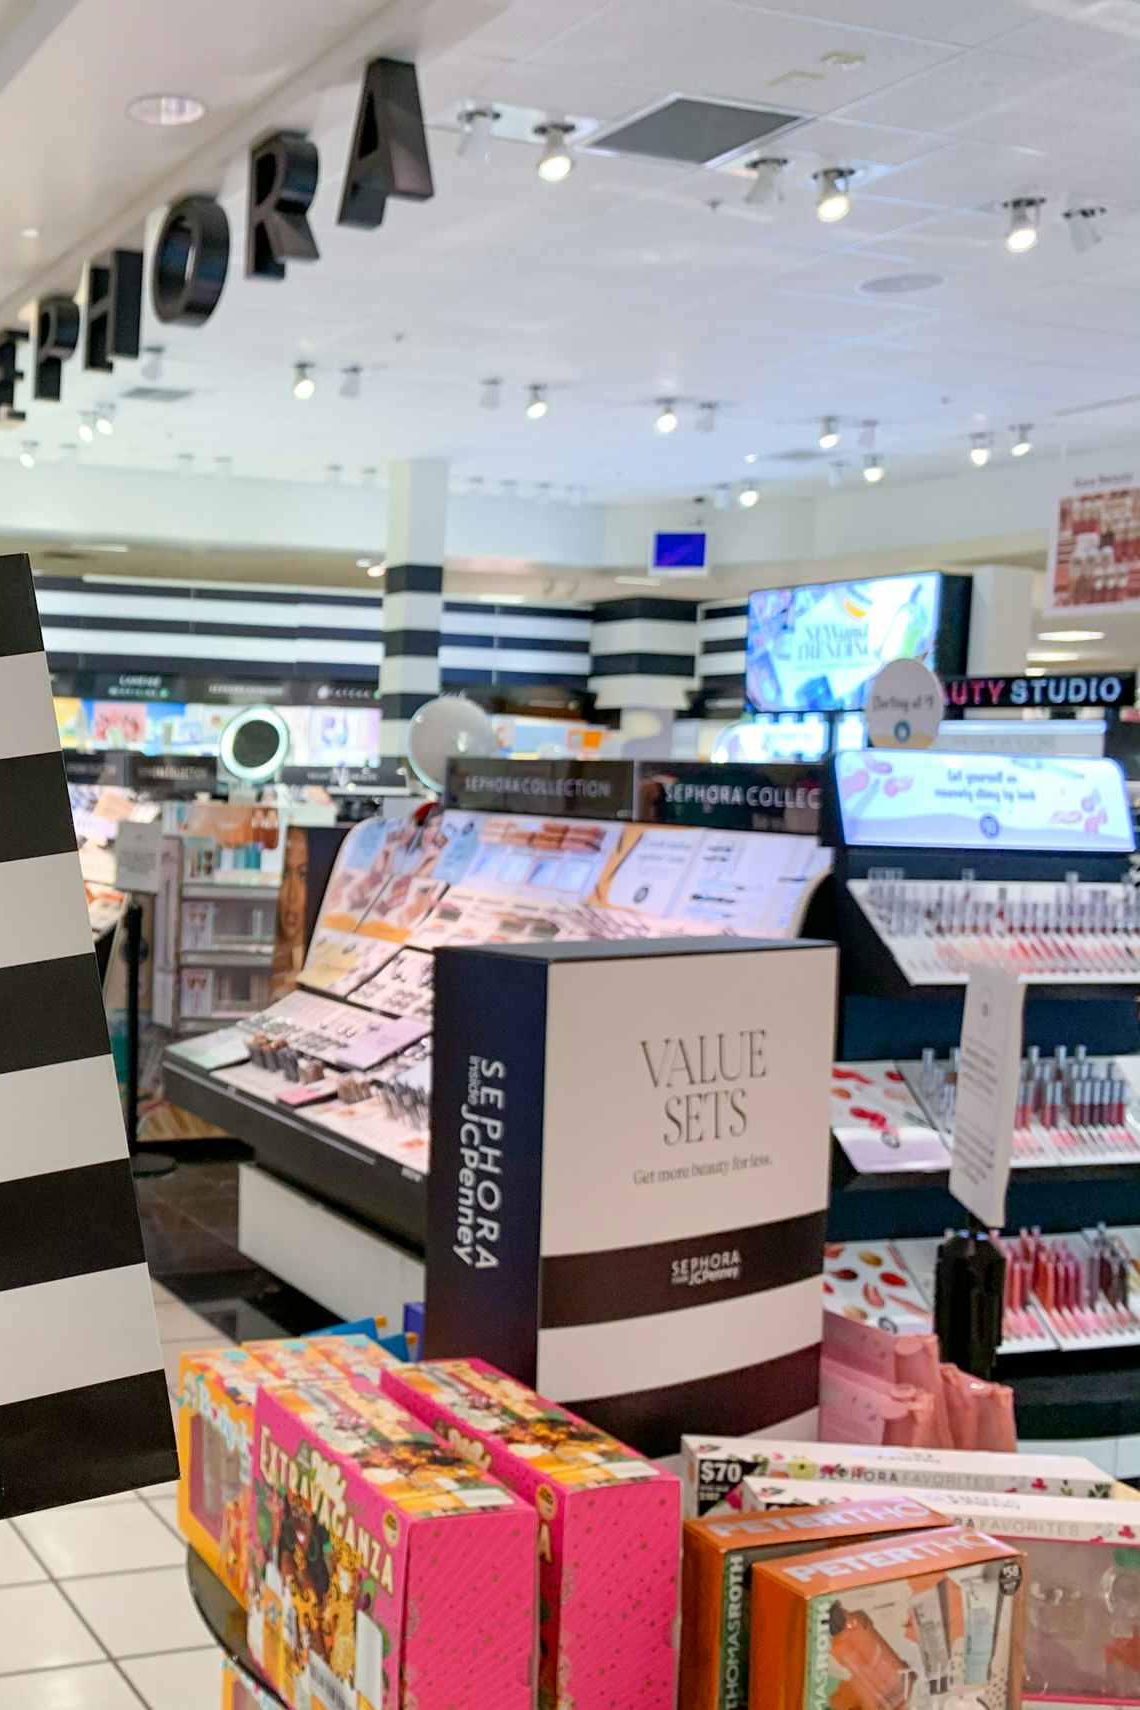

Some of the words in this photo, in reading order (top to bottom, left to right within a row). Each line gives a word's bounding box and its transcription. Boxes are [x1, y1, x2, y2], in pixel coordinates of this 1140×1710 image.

[1011, 676, 1122, 704] STUDIO
[641, 1029, 767, 1088] VALUE
[663, 1088, 747, 1146] SETS
[453, 1103, 481, 1267] JCPenney
[475, 1059, 506, 1269] SEPHORA
[657, 1165, 690, 1182] more
[692, 1160, 729, 1177] beauty
[732, 1155, 749, 1170] for
[671, 1249, 741, 1277] SEPHORA
[700, 1460, 742, 1484] $70
